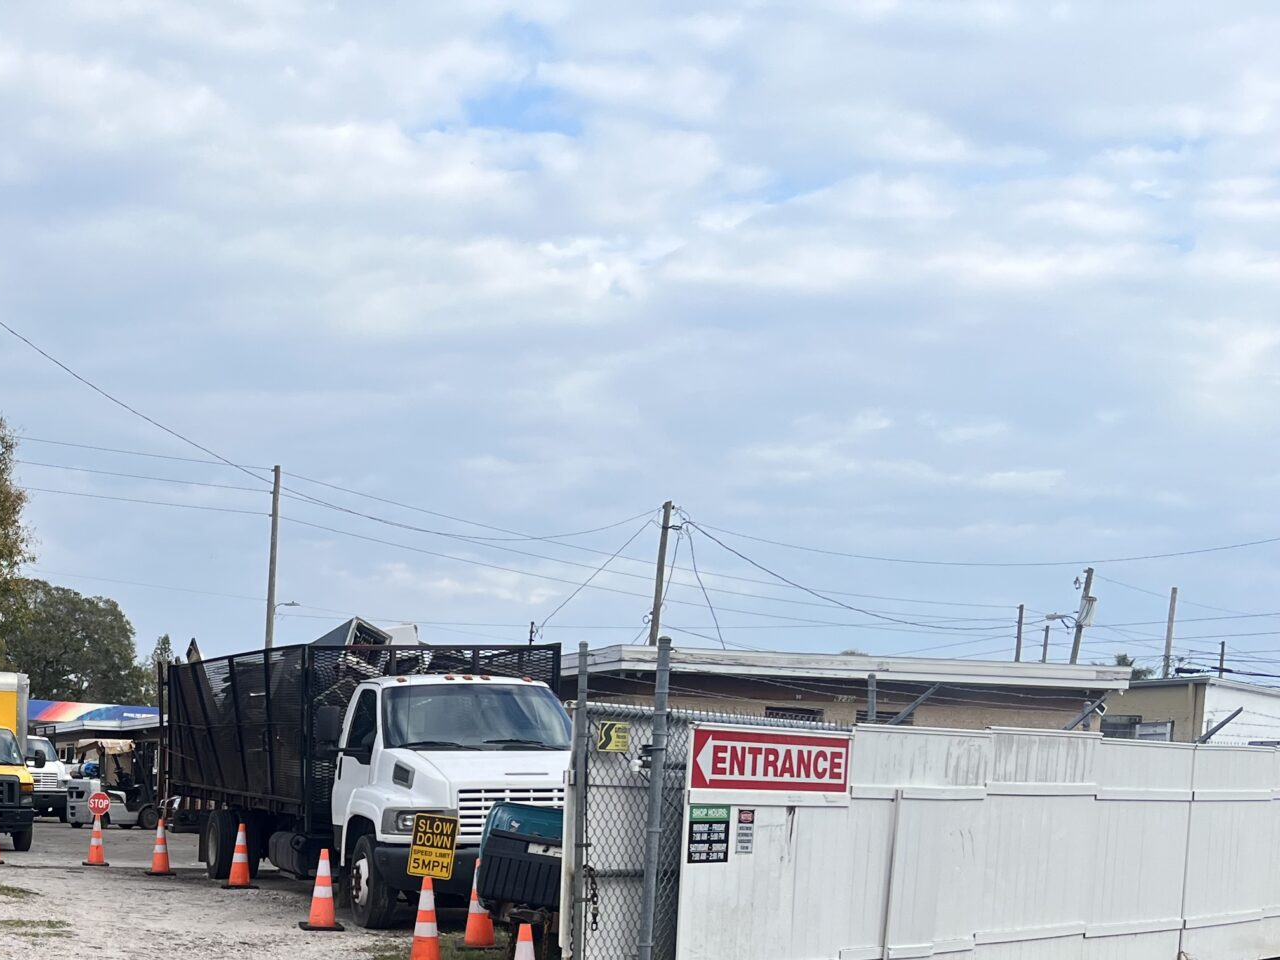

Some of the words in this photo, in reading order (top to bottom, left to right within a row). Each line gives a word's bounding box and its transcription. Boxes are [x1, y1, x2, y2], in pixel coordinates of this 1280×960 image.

[711, 745, 843, 780] ENTRANCE
[89, 798, 109, 809] STOP
[692, 808, 707, 818] SHOP
[418, 819, 454, 835] SLOW
[416, 832, 452, 848] DOWN
[413, 848, 433, 857] SPEED
[412, 857, 450, 873] 5MPH
